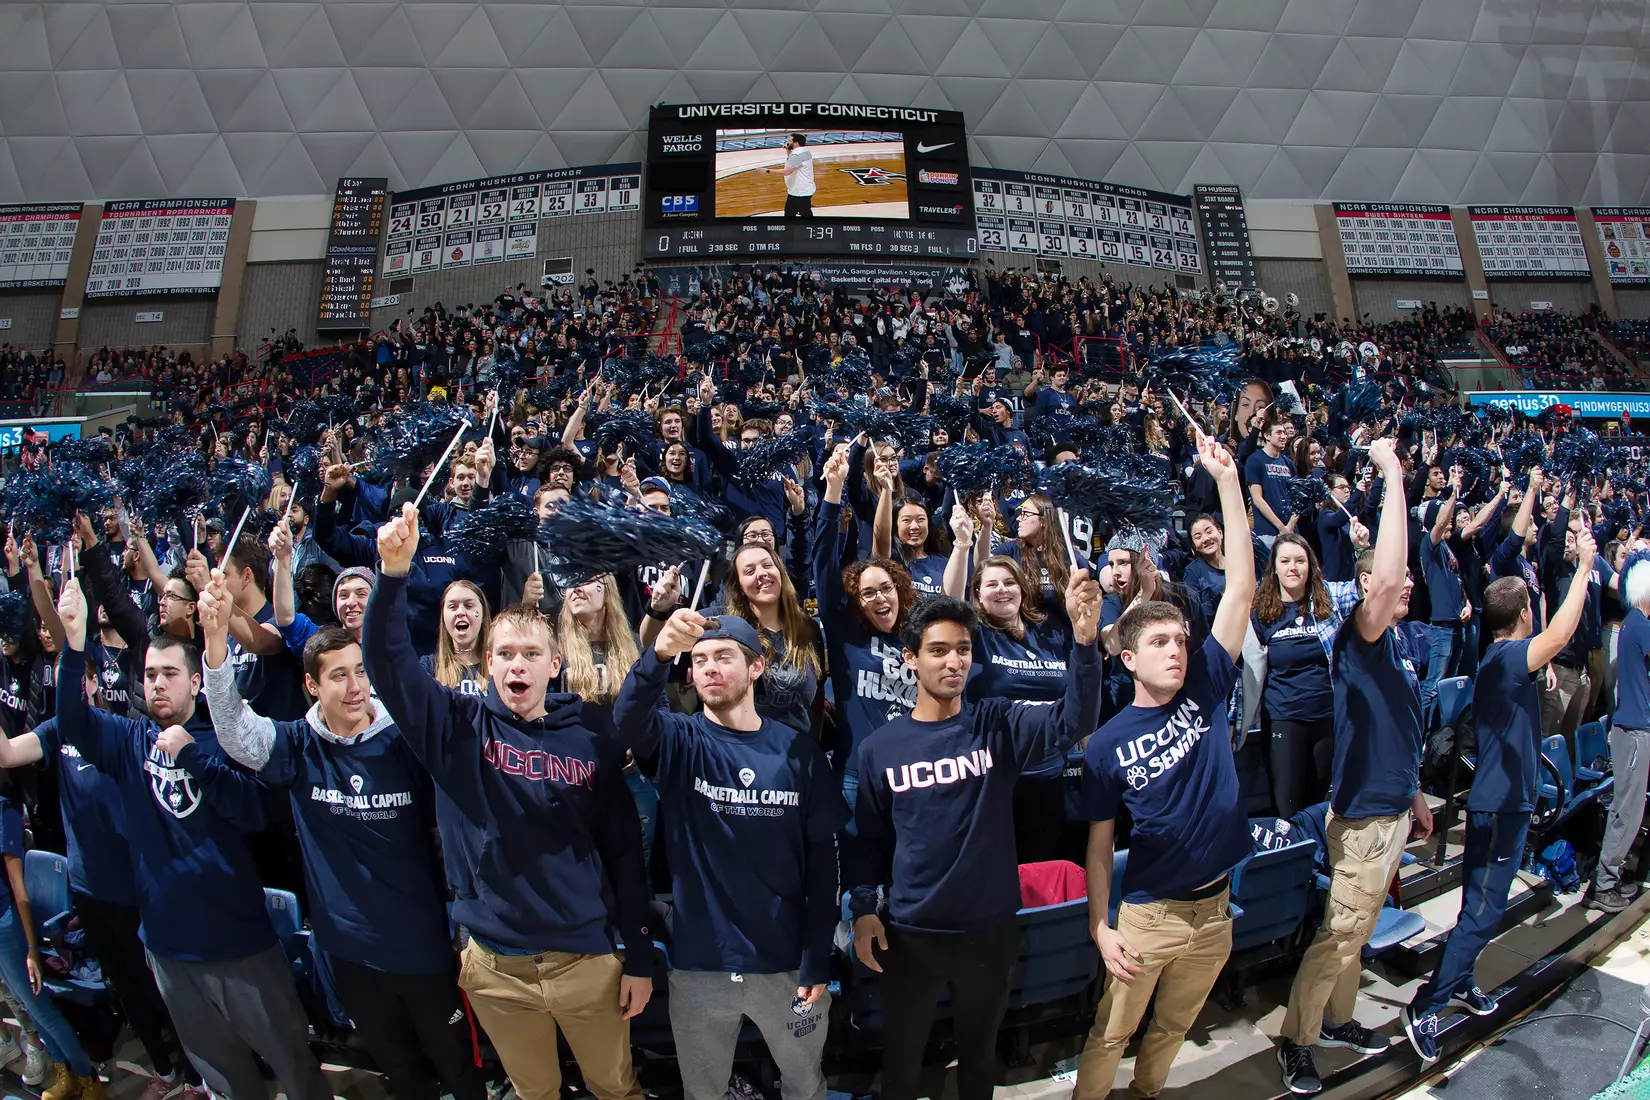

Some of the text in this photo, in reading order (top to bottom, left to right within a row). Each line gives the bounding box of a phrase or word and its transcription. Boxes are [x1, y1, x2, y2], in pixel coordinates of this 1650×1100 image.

[679, 104, 938, 122] UNIVERSITY OF CONNECTICUT
[662, 134, 702, 143] WELLS
[662, 144, 702, 152] FARGO
[442, 182, 475, 192] UCONN
[480, 176, 523, 186] HUSKIES
[547, 170, 581, 178] HONOR
[1025, 174, 1056, 183] UCONN
[1060, 179, 1100, 189] HUSKIES
[1119, 187, 1147, 197] HONOR
[145, 200, 227, 208] CHAMPIONSHIP
[549, 196, 565, 210] 25
[584, 193, 596, 207] 33
[619, 191, 629, 204] 10
[983, 194, 995, 207] 32
[1016, 197, 1022, 210] 3
[483, 204, 501, 218] 52
[514, 200, 535, 213] 42
[919, 206, 956, 214] TRAVELERS
[1072, 204, 1084, 217] 20
[421, 213, 440, 227] 50
[453, 208, 469, 223] 21
[1100, 207, 1110, 220] 31
[1126, 211, 1138, 224] 23
[139, 217, 209, 228] 1991 1992 1994
[392, 218, 410, 233] 24
[1152, 215, 1163, 228] 31
[1178, 220, 1188, 232] 14
[806, 227, 833, 239] 7:39
[982, 231, 1001, 244] 23
[659, 236, 669, 251] 0
[967, 238, 976, 253] 0
[1019, 234, 1028, 247] 4
[1045, 236, 1062, 250] 30
[1078, 239, 1087, 252] 3
[188, 246, 223, 255] 2008 2009
[1103, 242, 1118, 256] CD
[1131, 246, 1143, 259] 15
[1154, 250, 1172, 263] 24
[1180, 254, 1198, 267] 33
[92, 260, 220, 275] 2010 2011 2012 2013 2014 2015 2016
[89, 278, 140, 290] 2017 2019
[384, 296, 400, 305] 201
[423, 556, 455, 565] UCONN
[992, 654, 1043, 670] BASKETBALL
[882, 657, 918, 685] GO
[1116, 696, 1200, 767] UCONN
[484, 738, 595, 791] UCONN
[886, 745, 993, 793] UCONN
[311, 786, 412, 809] BASKEBALL CAPITAL
[694, 777, 799, 806] BASKETBALL CAPITA
[330, 806, 343, 814] OF
[361, 810, 398, 820] WORLD
[710, 802, 784, 817] OF THE WORLD
[786, 1013, 822, 1030] UCONN
